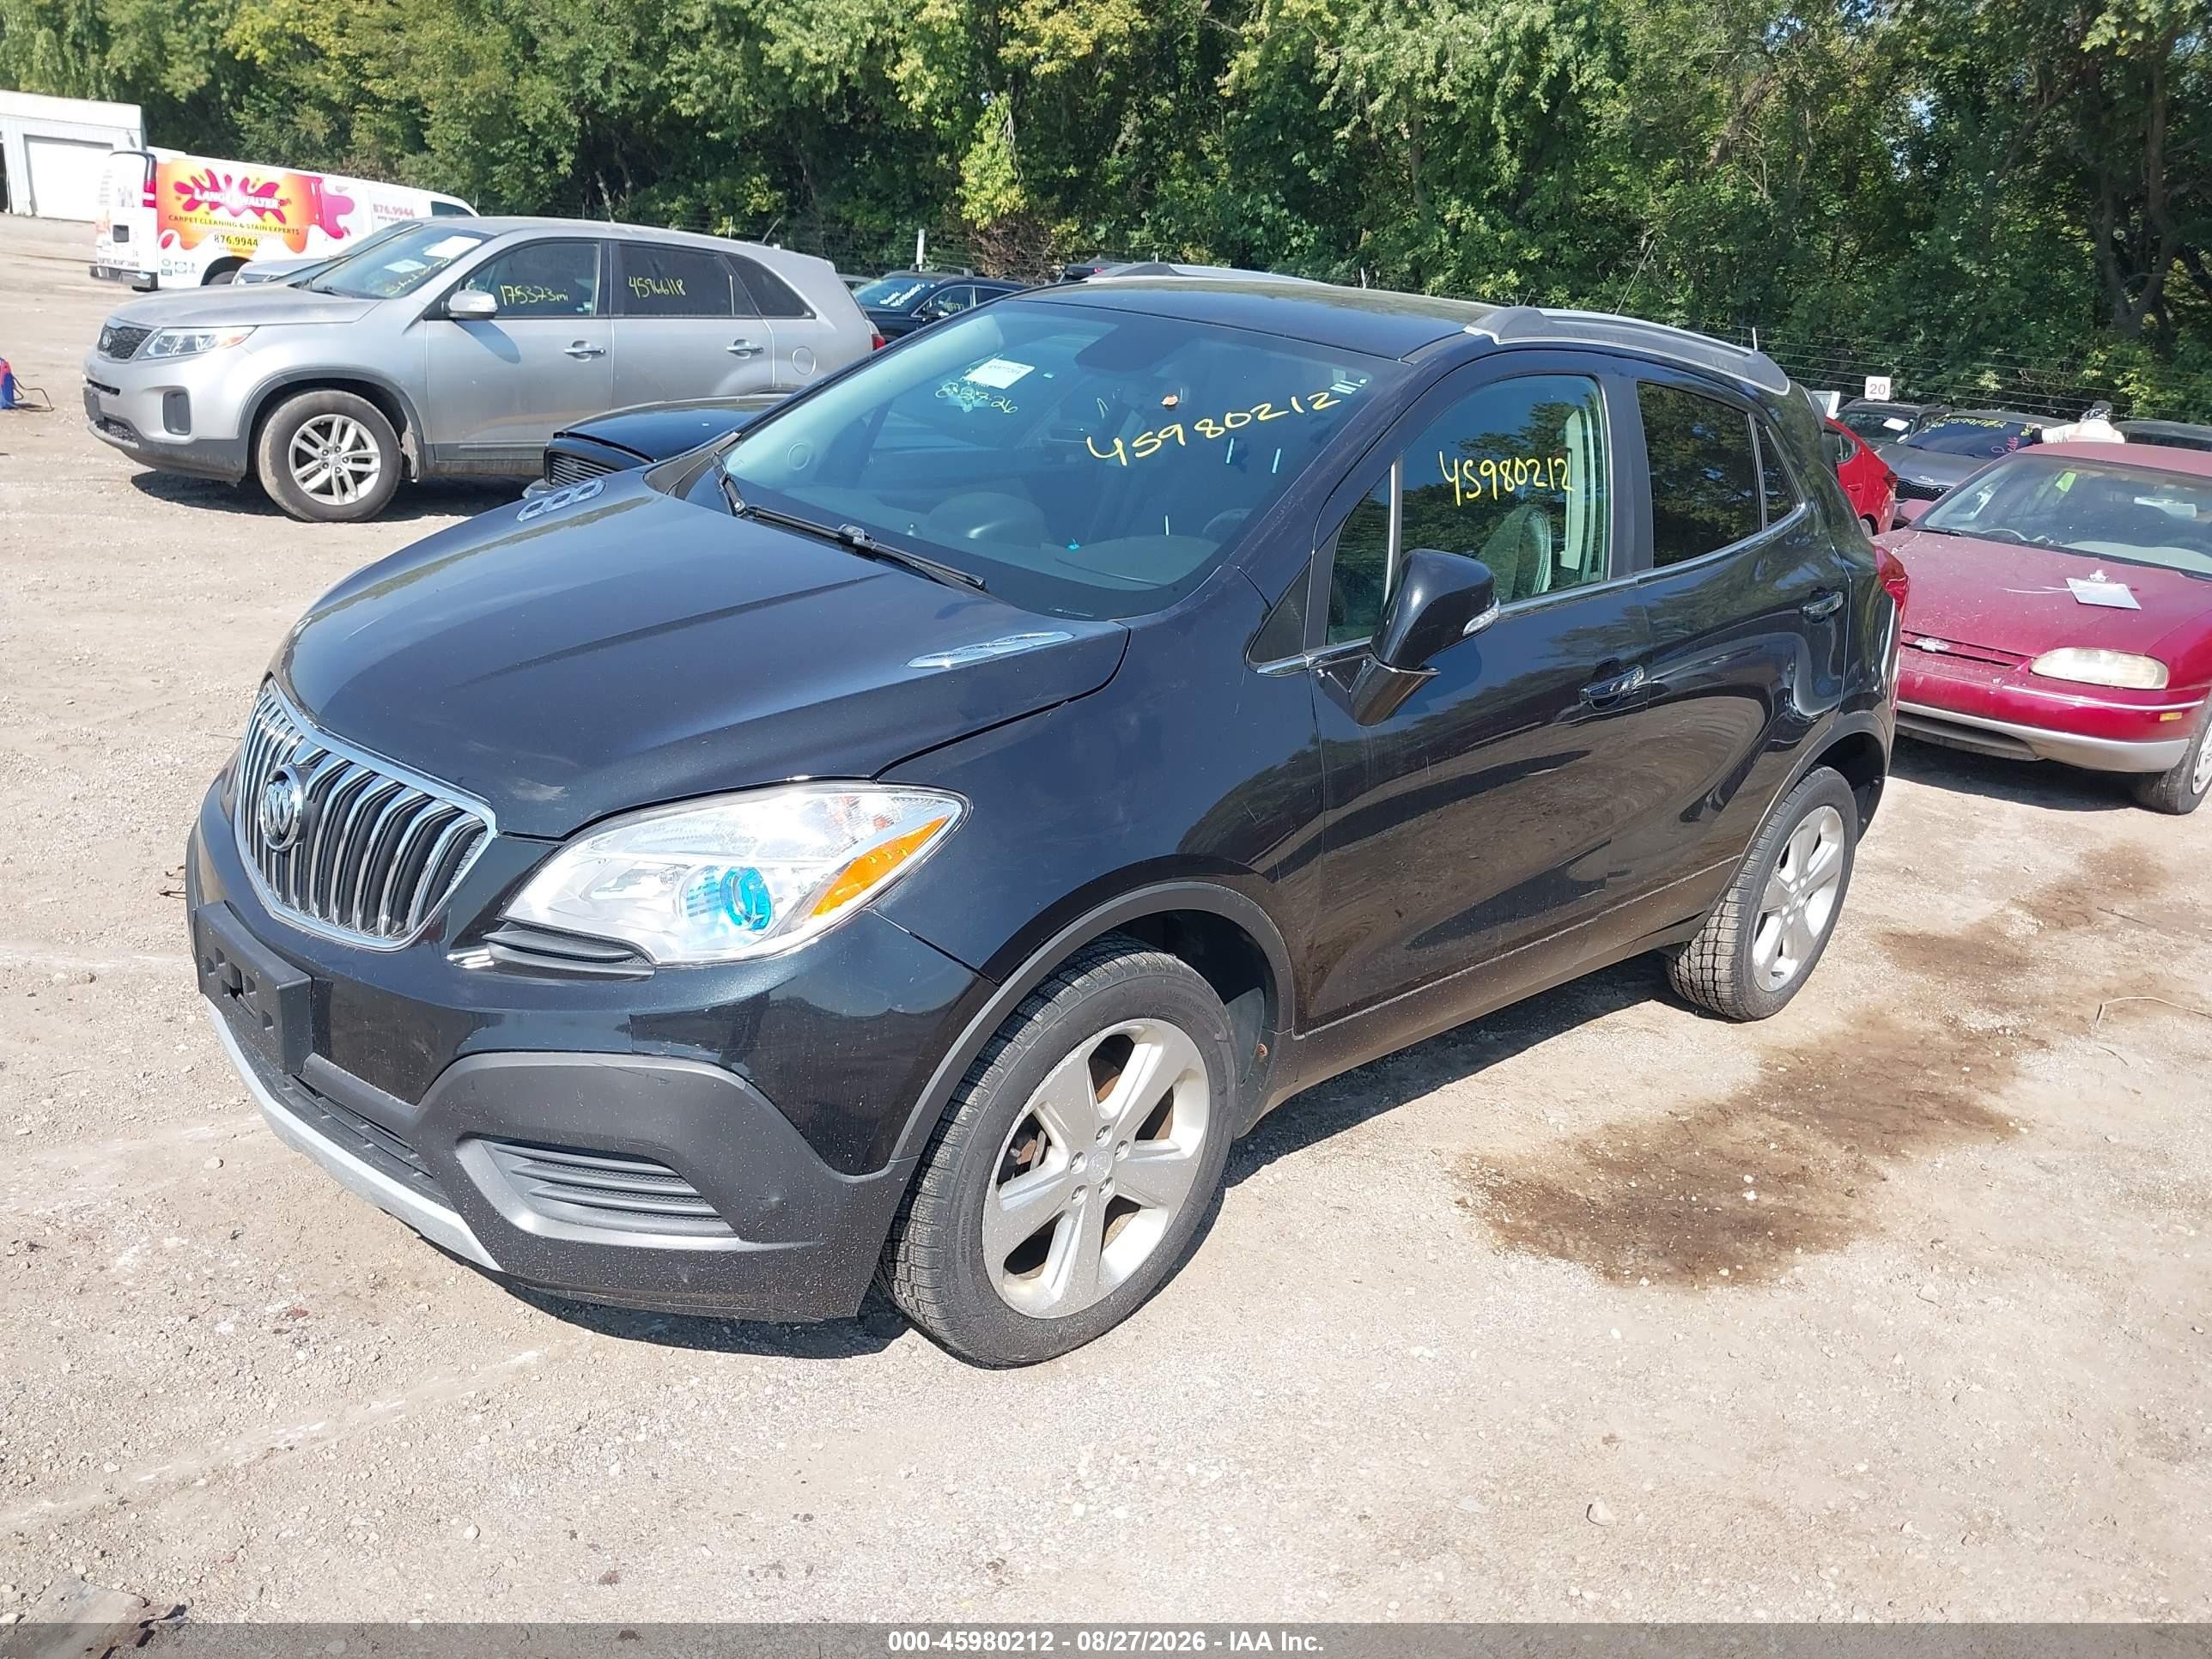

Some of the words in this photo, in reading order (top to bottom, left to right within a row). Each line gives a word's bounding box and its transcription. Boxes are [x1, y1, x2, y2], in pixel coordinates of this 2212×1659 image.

[373, 204, 414, 217] 876.9944
[168, 215, 198, 225] CARPET
[199, 216, 237, 228] CLEANING
[246, 223, 268, 232] STAIN
[269, 225, 300, 236] EXPERTS
[214, 234, 258, 248] 876.9944
[1869, 384, 1886, 395] 20
[1438, 449, 1576, 507] 45980212
